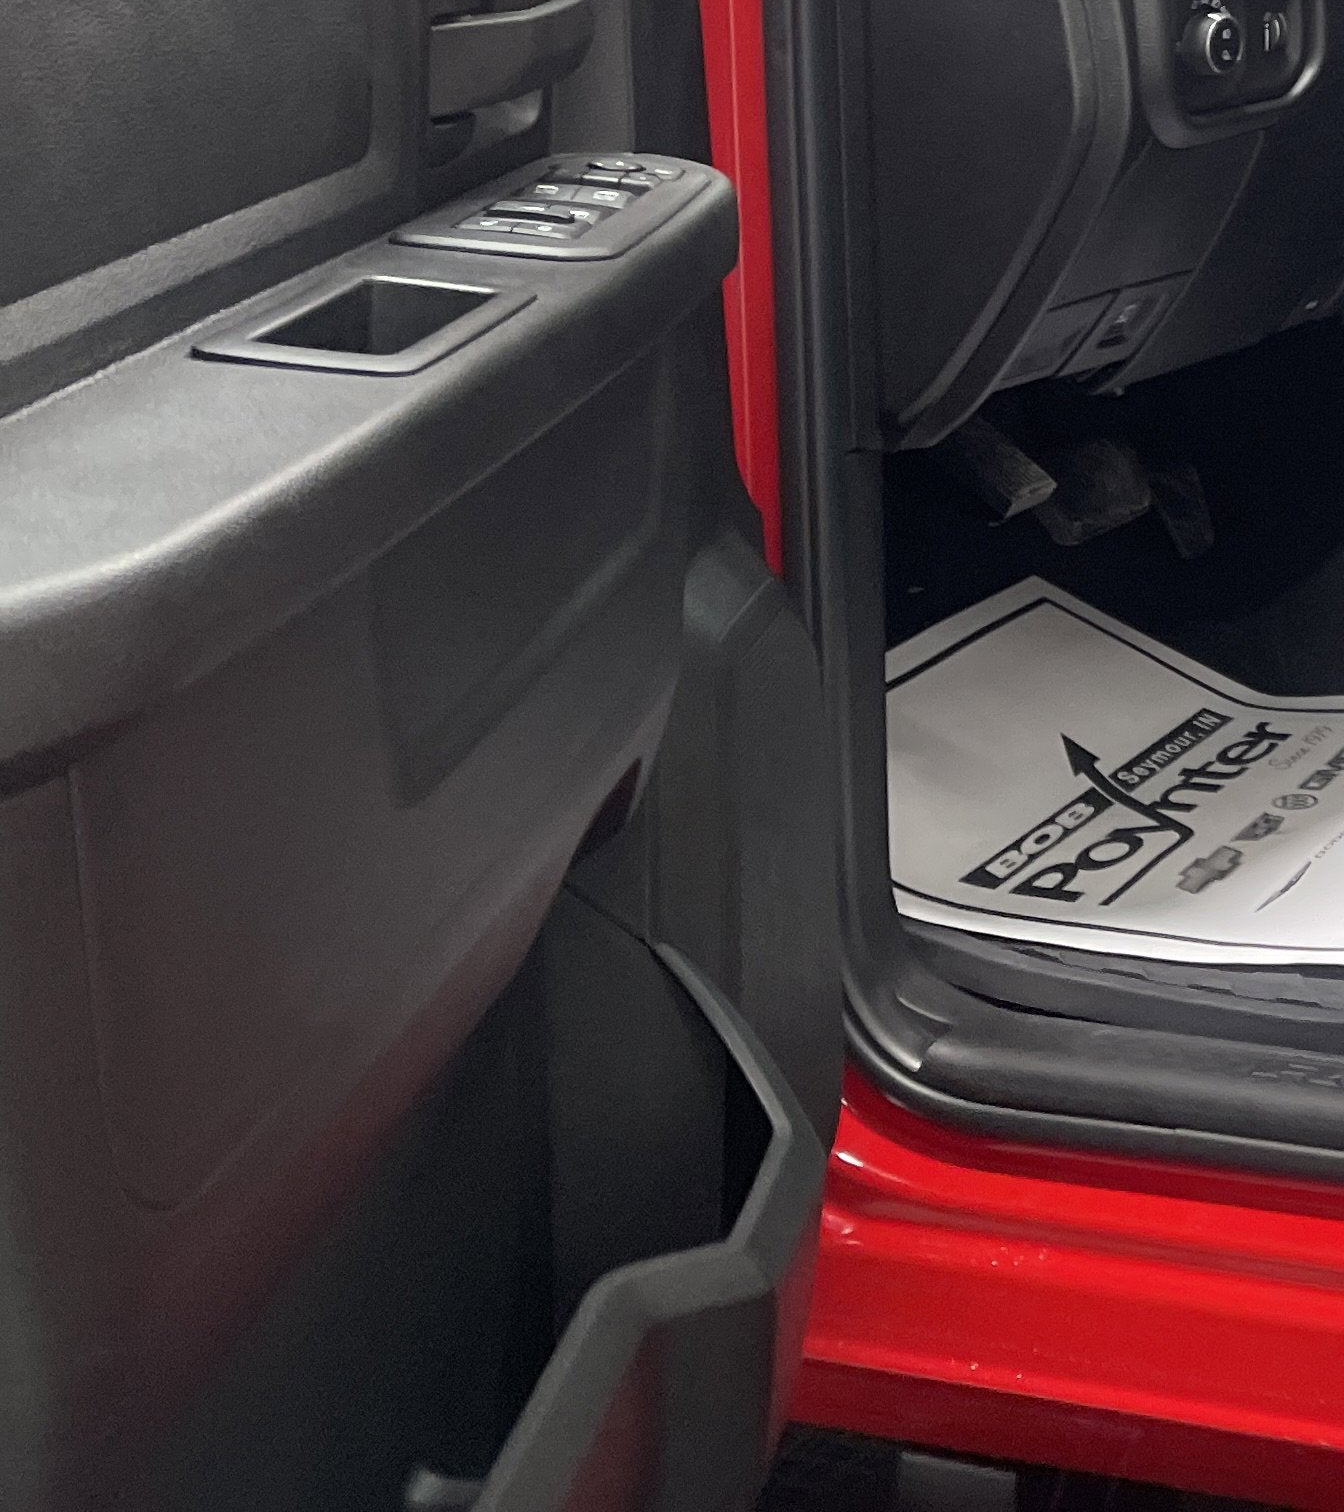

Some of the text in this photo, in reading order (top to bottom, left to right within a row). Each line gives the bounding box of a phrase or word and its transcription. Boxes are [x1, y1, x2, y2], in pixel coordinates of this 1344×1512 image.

[1116, 713, 1222, 785] Seymour, IN
[984, 801, 1095, 879] BOB
